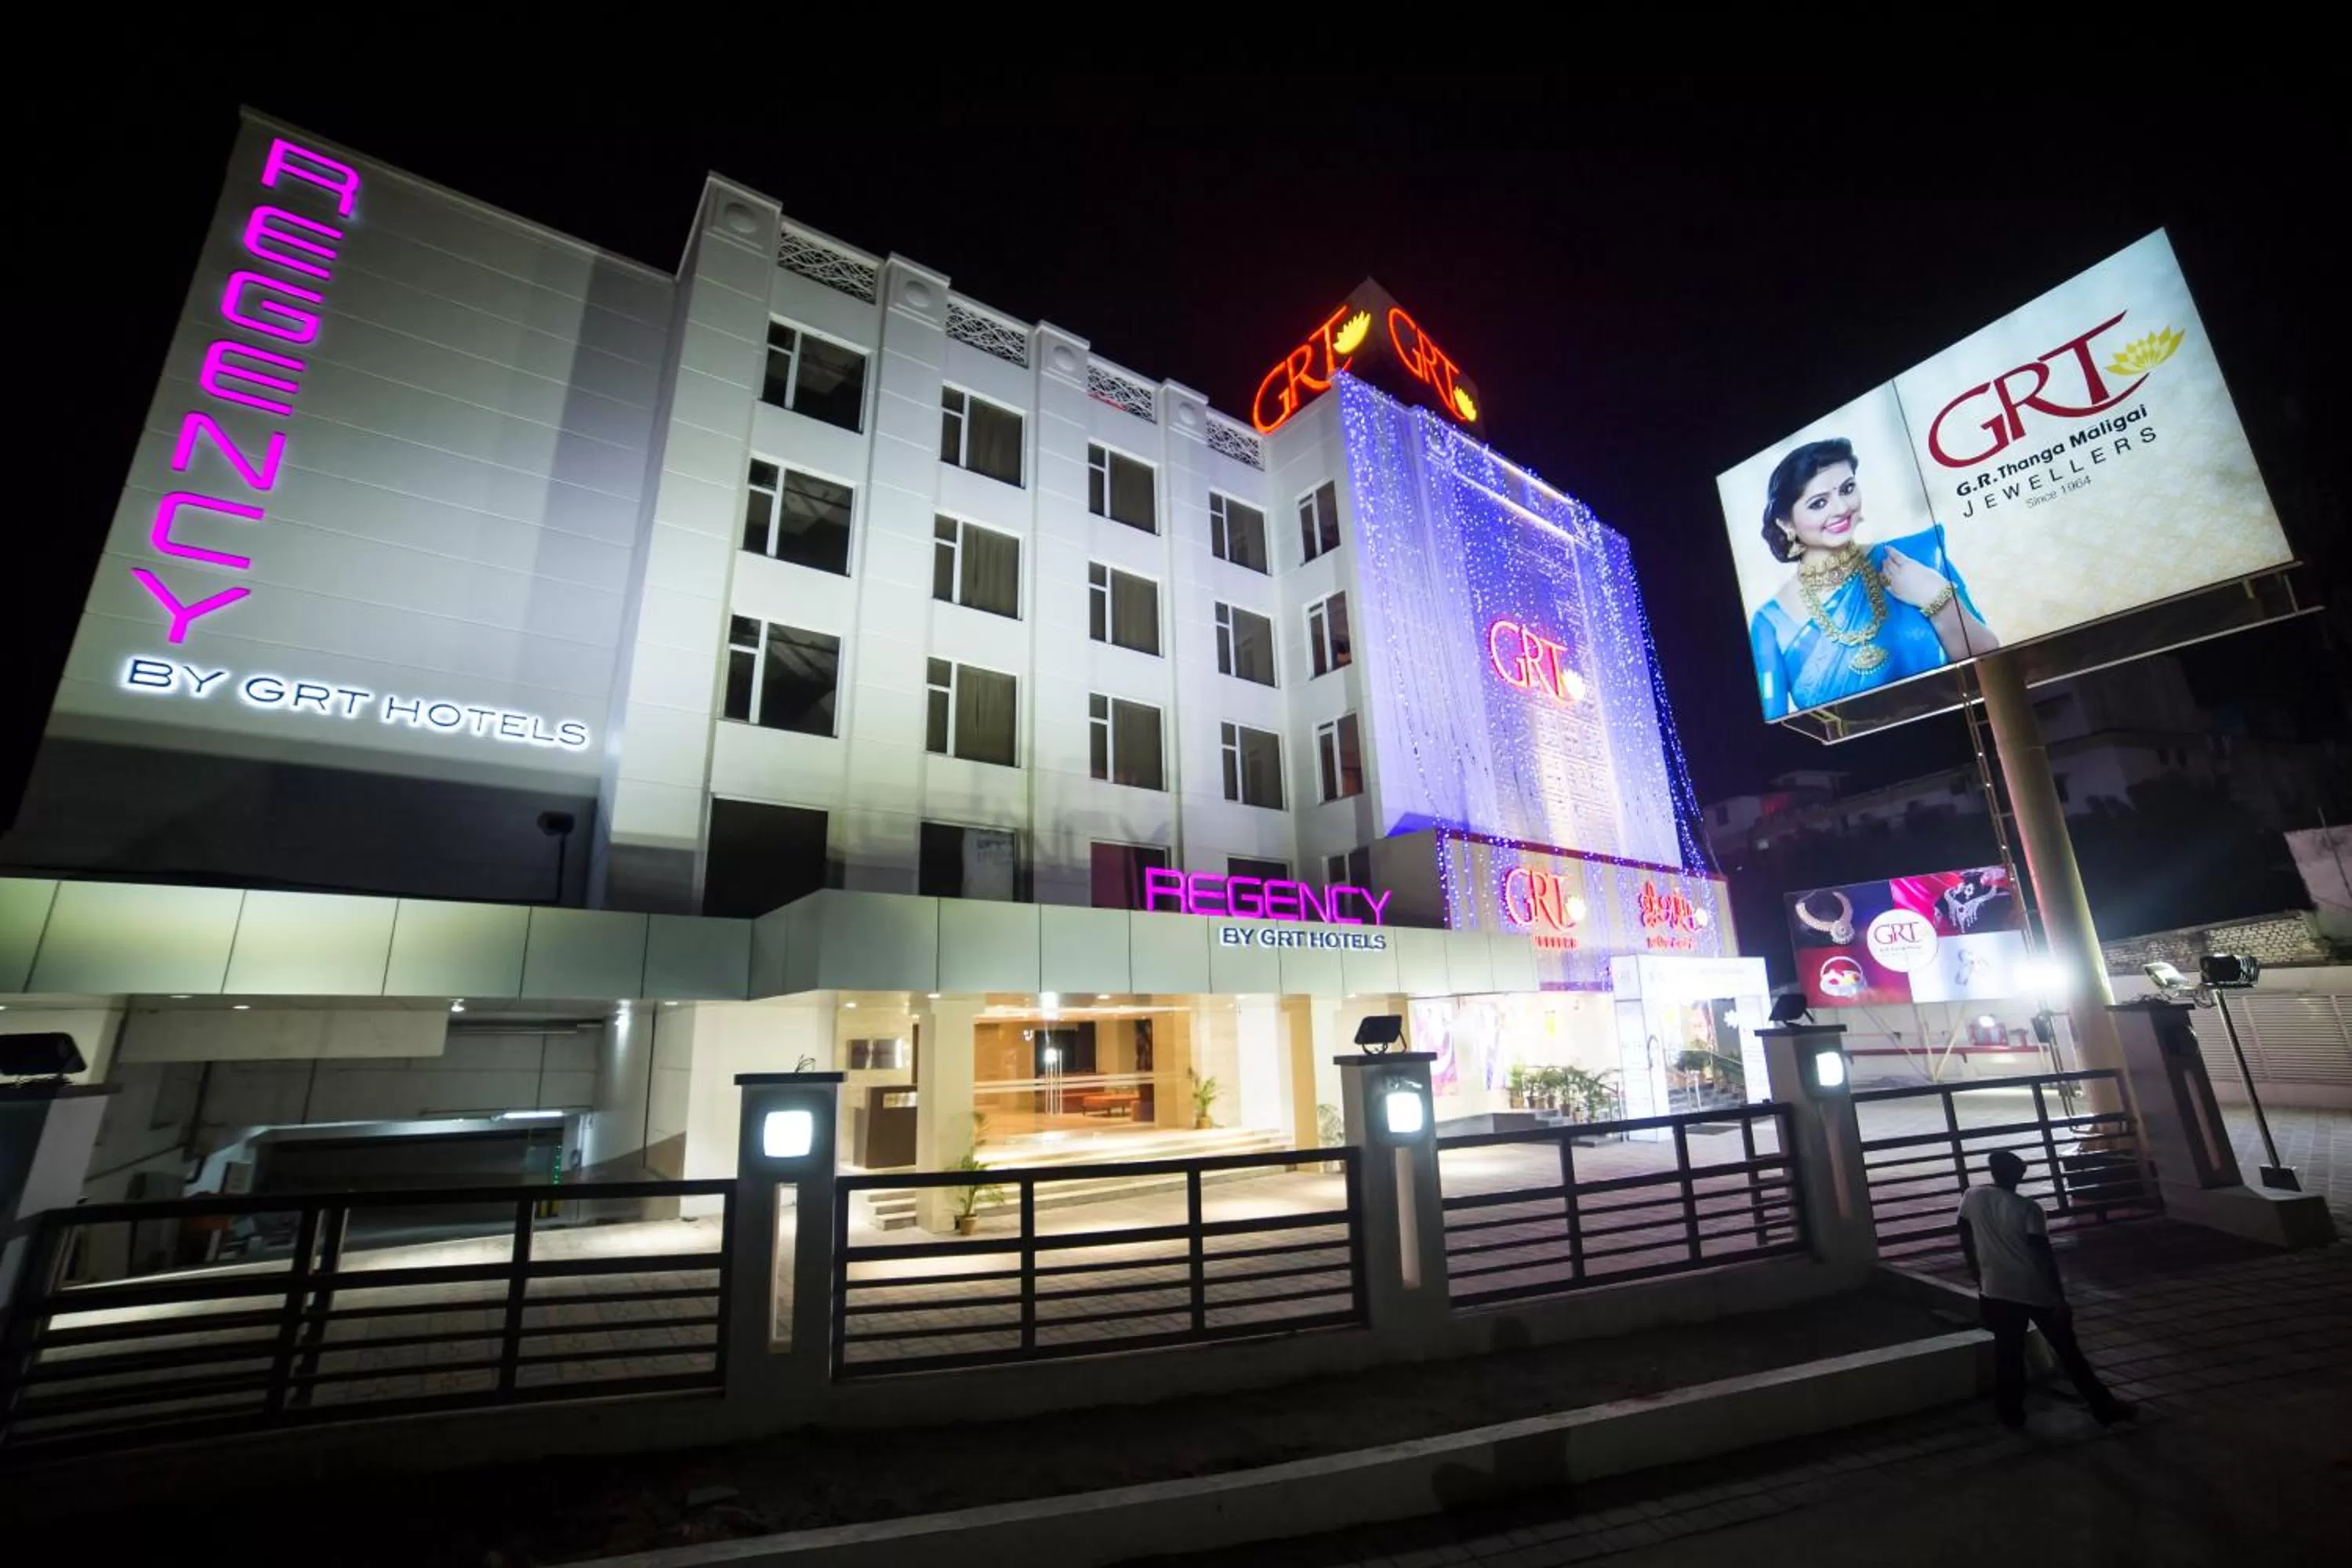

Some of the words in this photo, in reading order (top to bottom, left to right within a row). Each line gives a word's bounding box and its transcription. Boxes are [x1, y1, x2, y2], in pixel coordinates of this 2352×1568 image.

[130, 137, 361, 644] REGENCY
[1253, 304, 1353, 435] GRT
[1386, 307, 1468, 421] GRT
[1928, 309, 2150, 469] GRT
[2068, 404, 2149, 448] Maligai
[1962, 426, 2158, 519] JEWELLERS
[2025, 489, 2059, 510] Since
[126, 658, 226, 694] BY
[245, 676, 370, 715] GRT
[384, 695, 589, 747] HOTELS
[1487, 619, 1577, 706] GRT
[1145, 866, 1392, 926] REGENCY
[1221, 927, 1255, 946] BY
[1259, 927, 1306, 949] GRT
[1308, 931, 1388, 951] HOTELS
[1503, 866, 1579, 933] GRT
[1873, 920, 1924, 945] GRT
